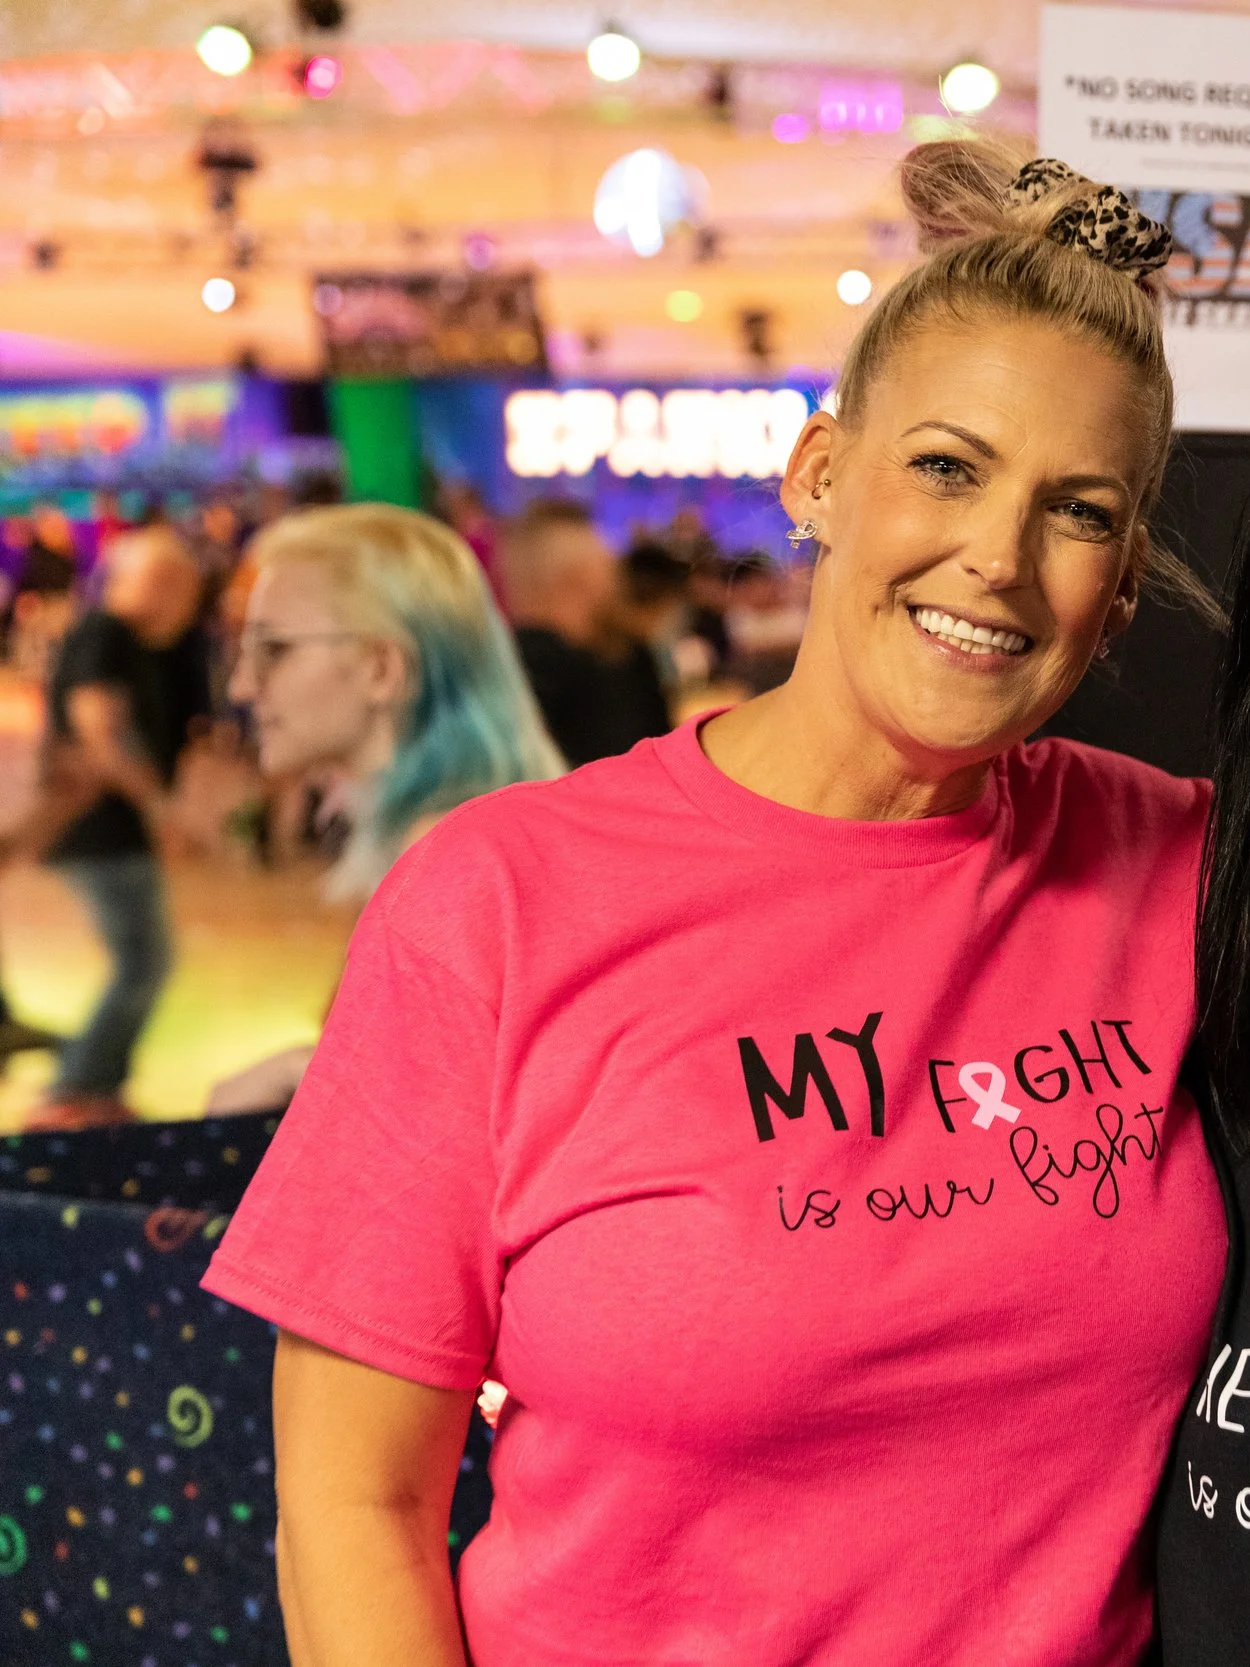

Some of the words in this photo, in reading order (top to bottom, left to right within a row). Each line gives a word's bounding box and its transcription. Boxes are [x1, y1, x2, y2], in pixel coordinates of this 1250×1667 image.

[1124, 77, 1199, 104] SONG
[1088, 115, 1173, 145] TAKEN
[737, 1011, 885, 1142] MY
[778, 1185, 840, 1231] is
[866, 1177, 994, 1222] our
[1010, 1103, 1164, 1219] fight
[1187, 1461, 1218, 1519] is
